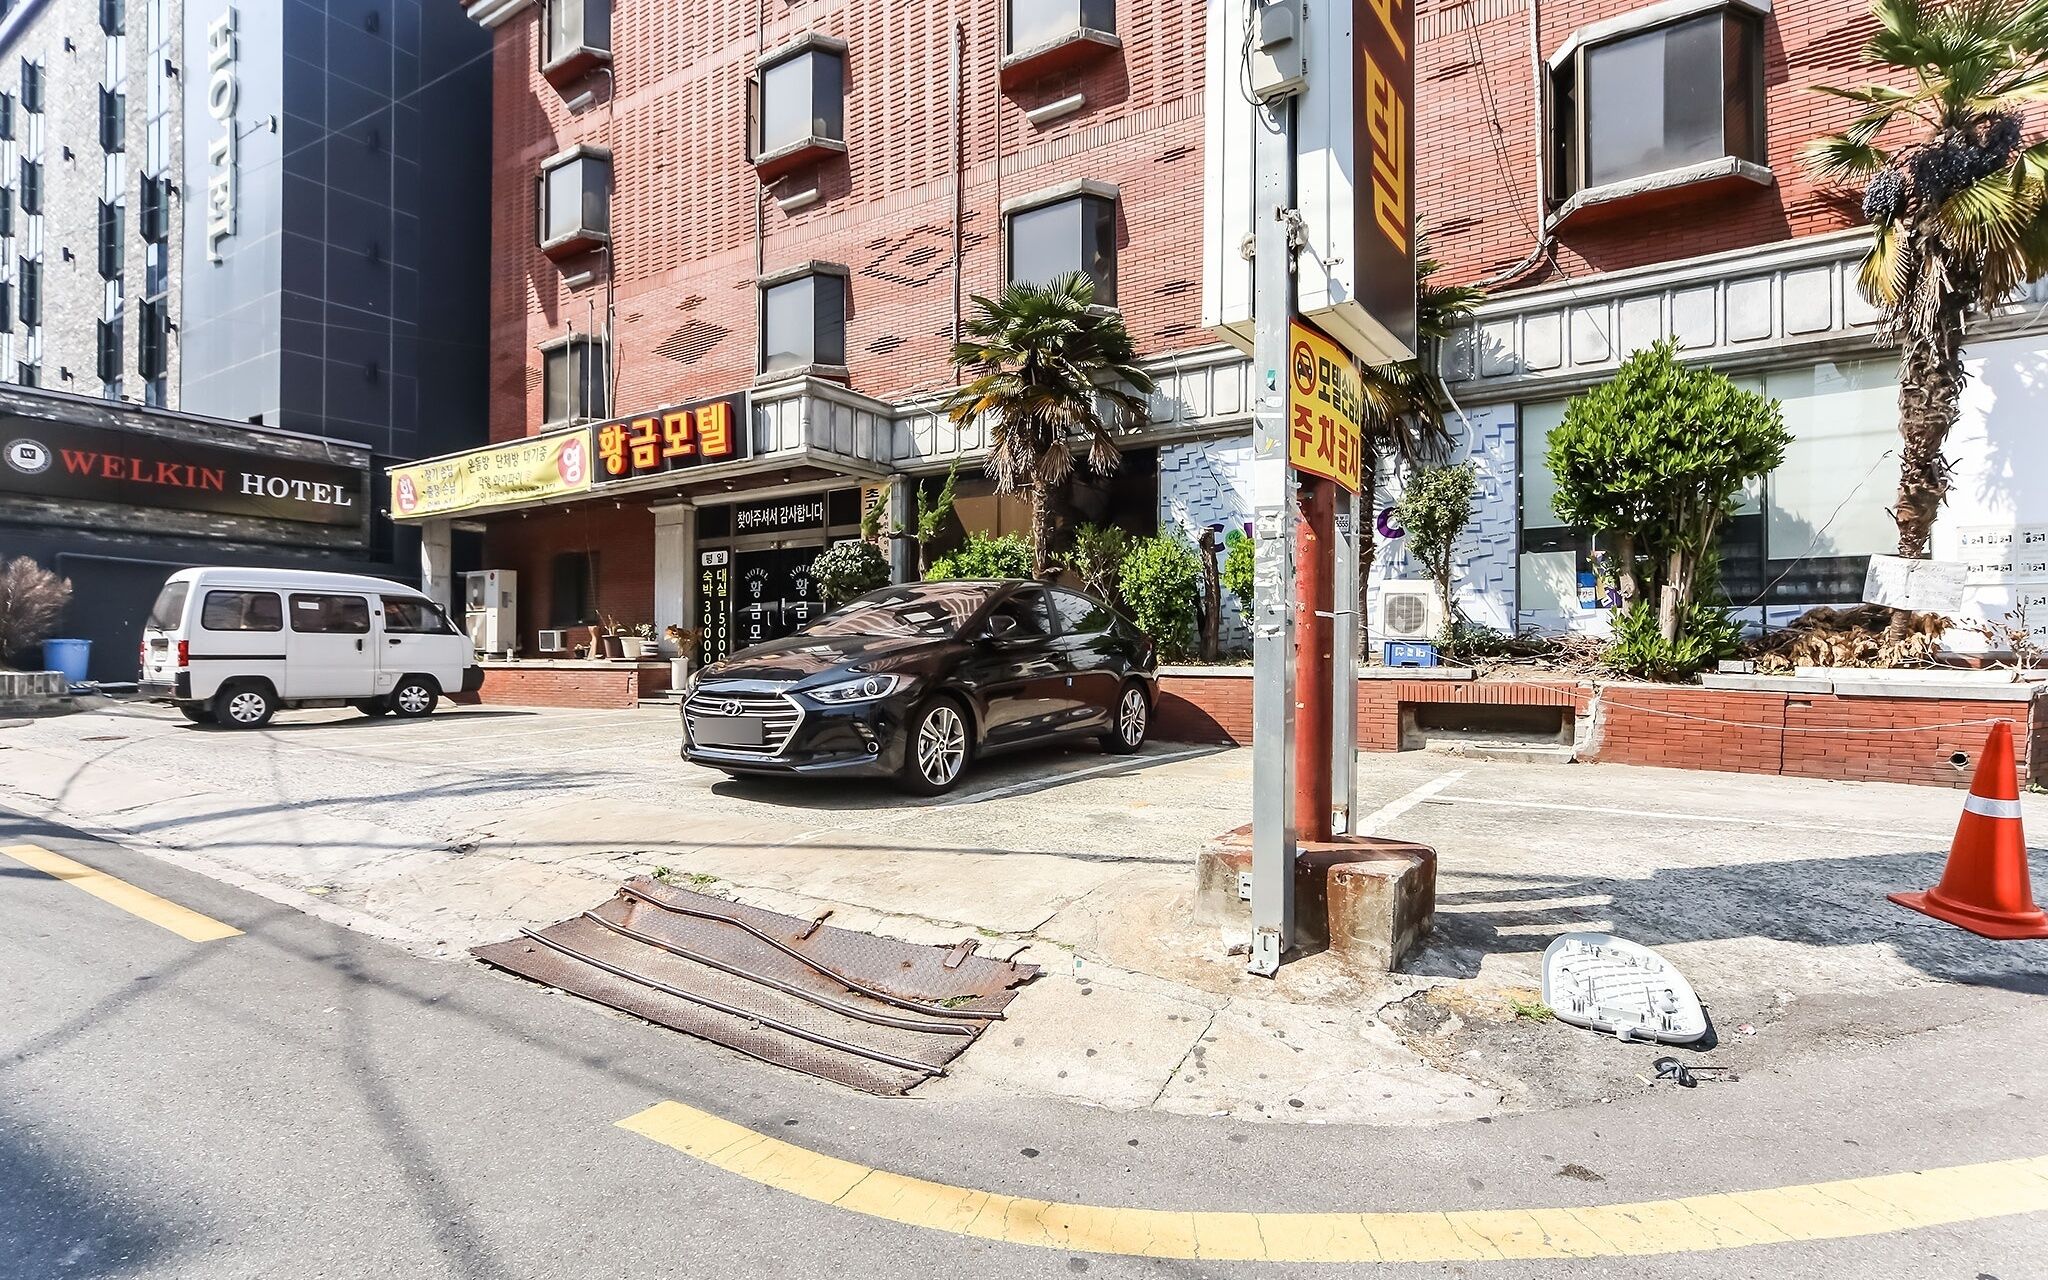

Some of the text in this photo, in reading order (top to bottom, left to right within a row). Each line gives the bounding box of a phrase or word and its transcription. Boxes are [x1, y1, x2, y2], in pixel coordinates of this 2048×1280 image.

[208, 5, 236, 264] HOTEL
[599, 400, 733, 476] 황금모텔
[1294, 403, 1359, 483] 주차금지
[496, 451, 519, 469] 단체방
[60, 448, 351, 506] WELKIN HOTEL
[737, 501, 823, 529] 찾아주셔서 감사합니다
[2000, 535, 2012, 543] 2+1
[2033, 533, 2045, 542] 2+1
[705, 552, 724, 565] 평일
[2000, 563, 2012, 572] 2+1
[2033, 563, 2046, 571] 2+1
[703, 569, 714, 598] 숙박
[716, 568, 727, 597] 대실
[745, 568, 769, 581] MOTEL
[749, 580, 763, 647] 황금모
[2033, 597, 2046, 605] 2+1
[2033, 626, 2046, 635] 2+1
